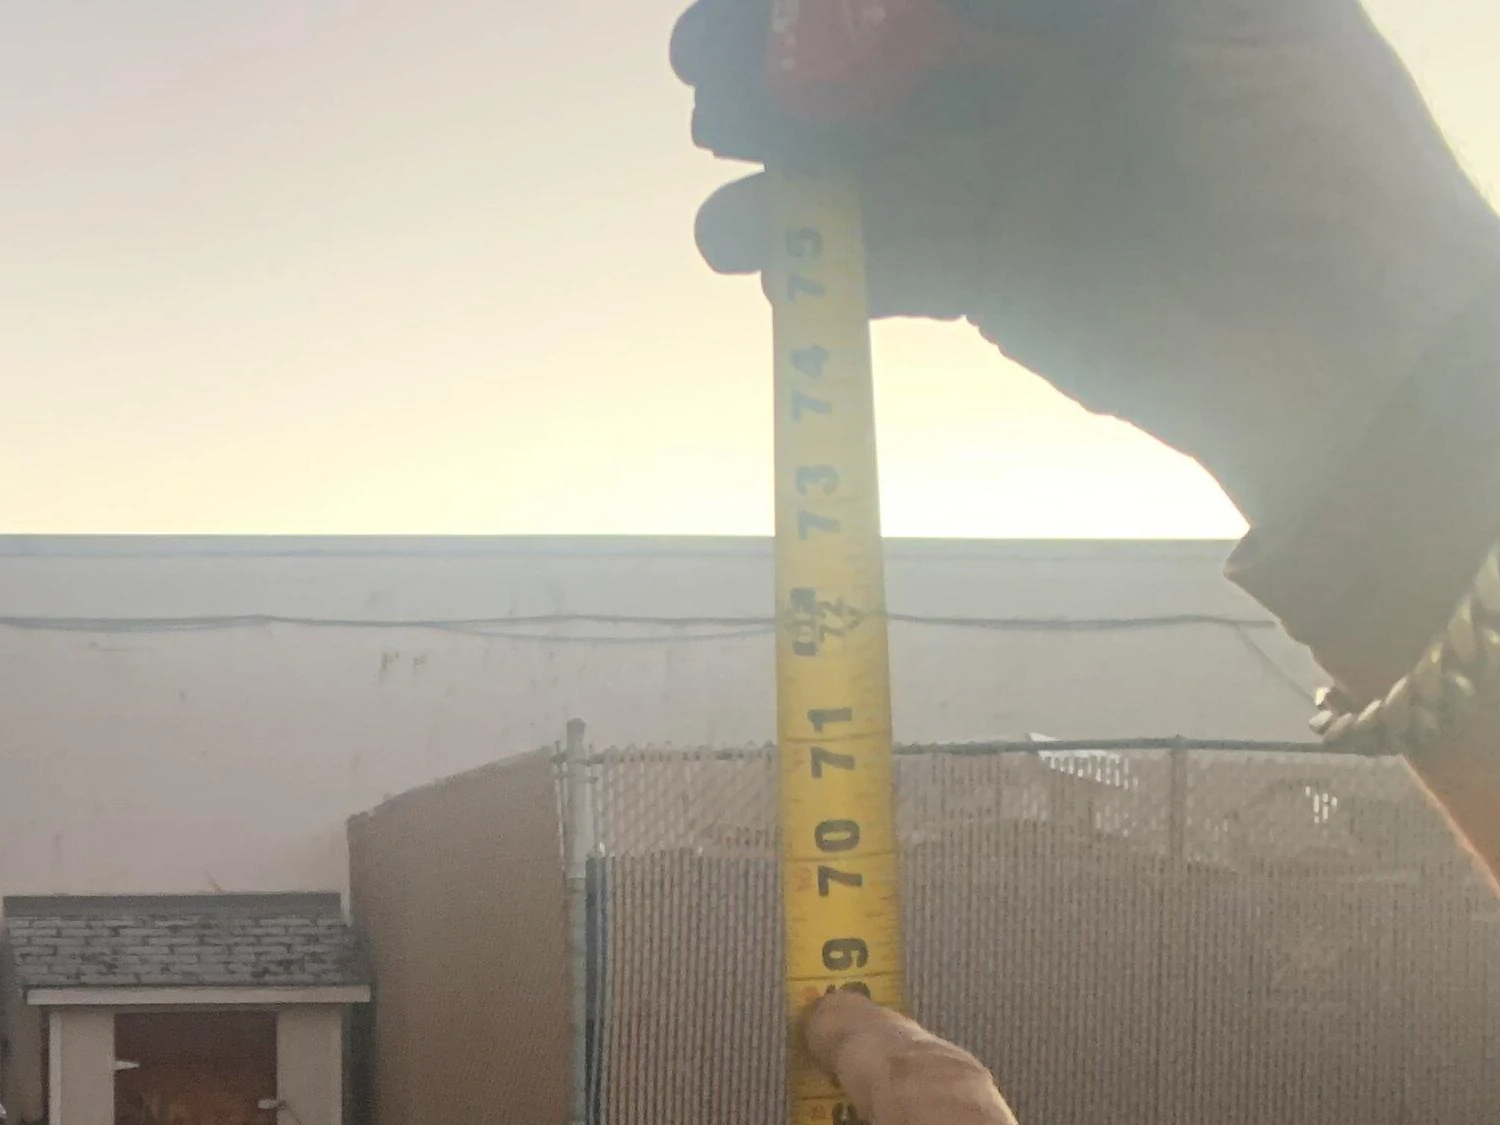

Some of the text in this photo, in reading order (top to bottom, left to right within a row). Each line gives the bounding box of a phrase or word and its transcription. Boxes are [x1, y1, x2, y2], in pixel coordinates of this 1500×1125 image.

[785, 227, 825, 302] 75
[790, 345, 833, 422] 74
[796, 463, 840, 541] 73
[806, 706, 856, 779] 71
[813, 818, 863, 898] 70
